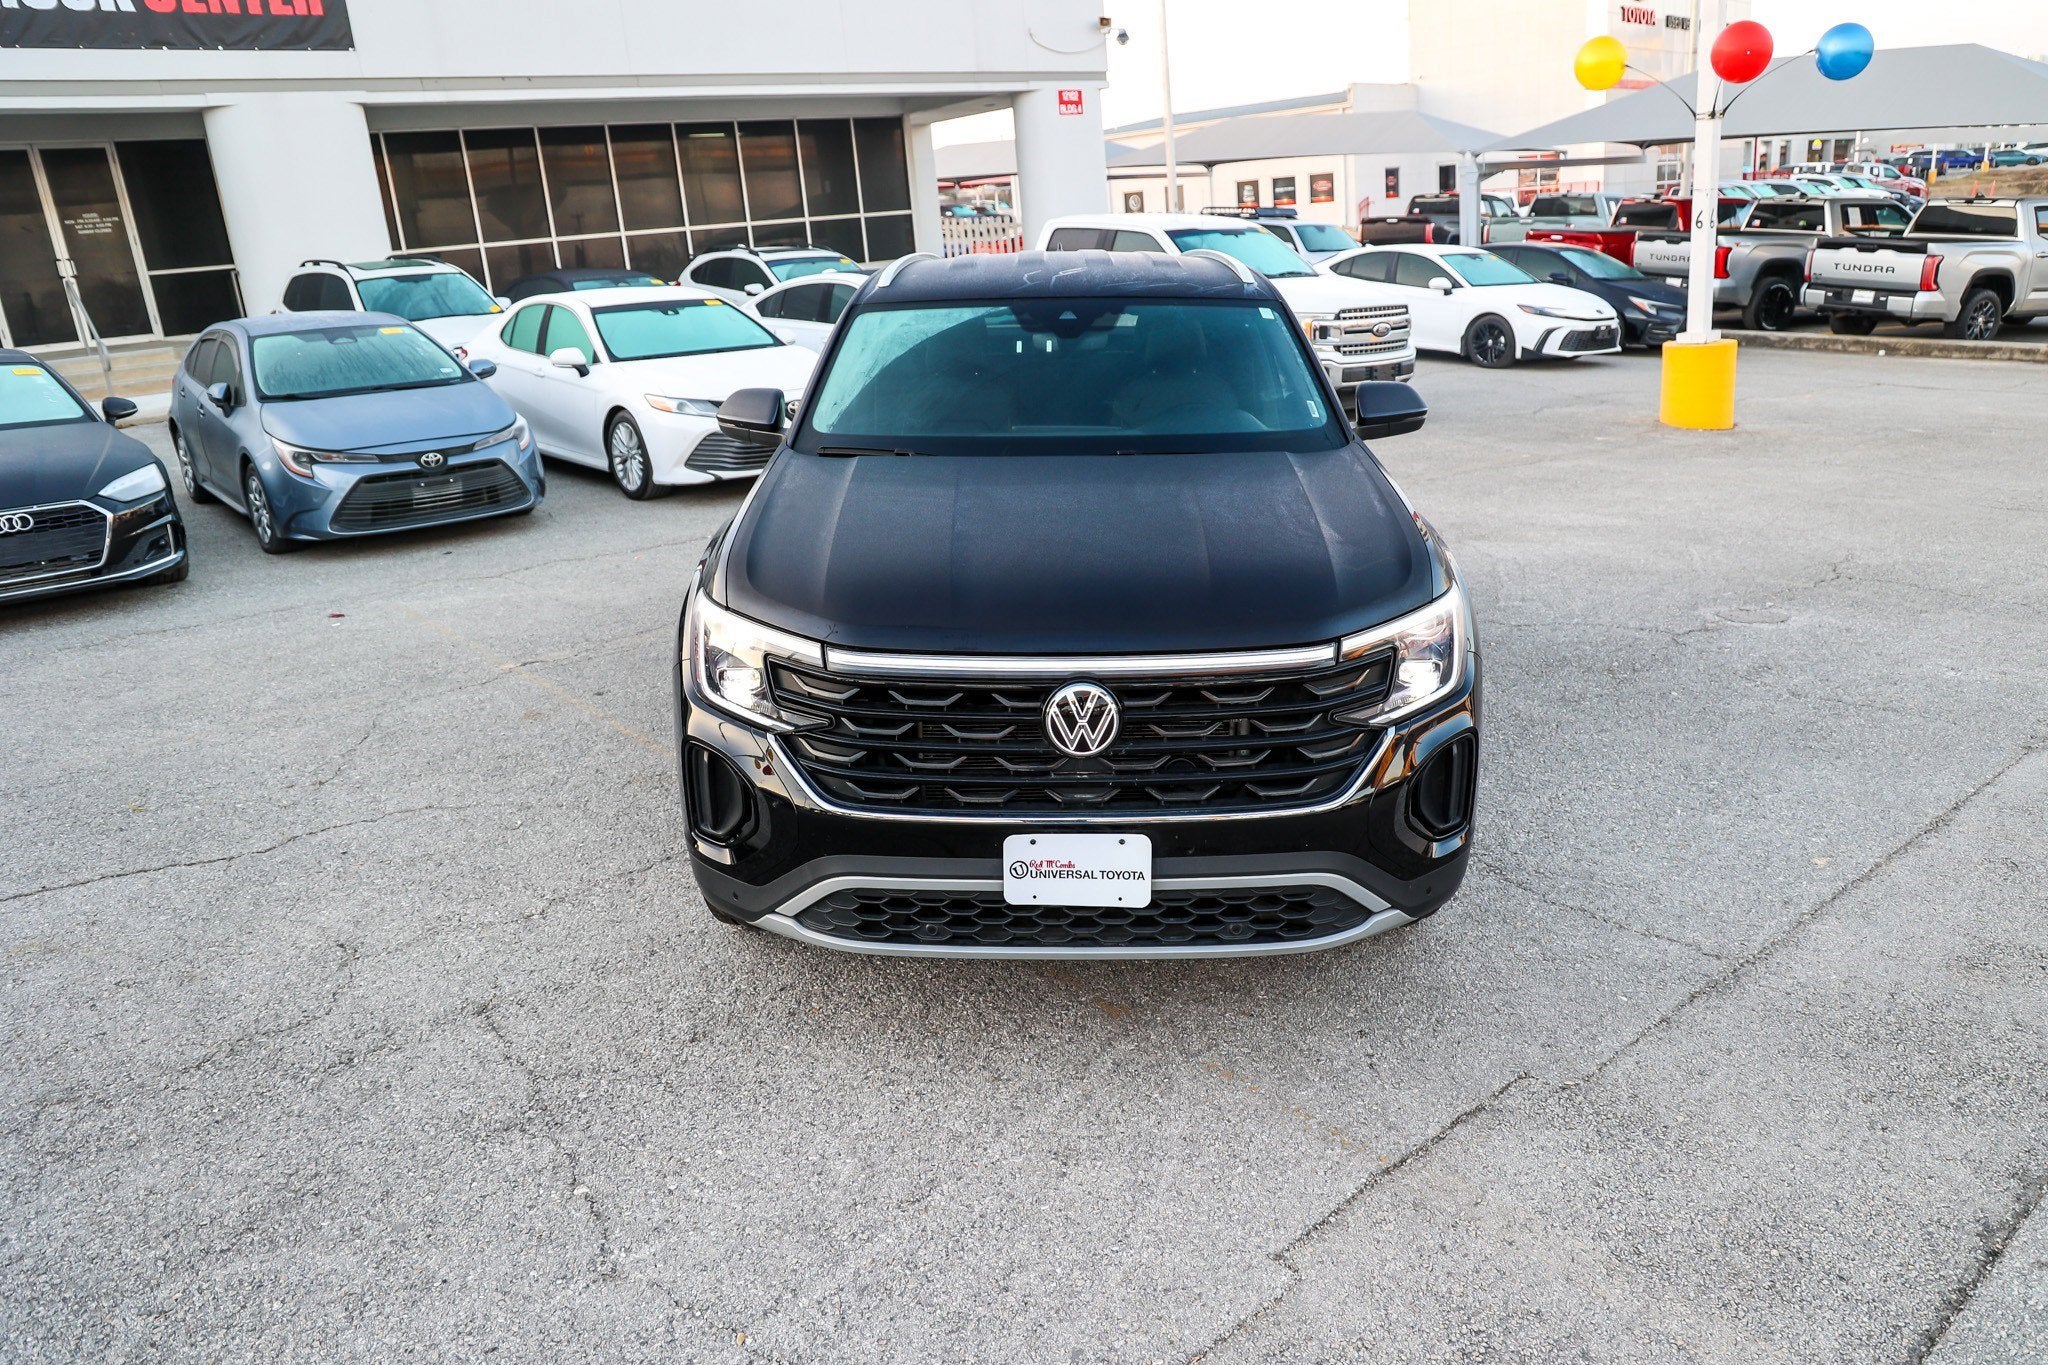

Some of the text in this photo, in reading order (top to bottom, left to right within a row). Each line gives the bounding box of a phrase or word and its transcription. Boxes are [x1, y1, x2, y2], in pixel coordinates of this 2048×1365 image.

[1621, 6, 1656, 25] TOYOTA
[1696, 210, 1703, 229] 6
[1834, 263, 1895, 274] TUNDRA
[1030, 860, 1043, 871] Red
[1030, 869, 1145, 880] UNIVERSAL TOYOTA
